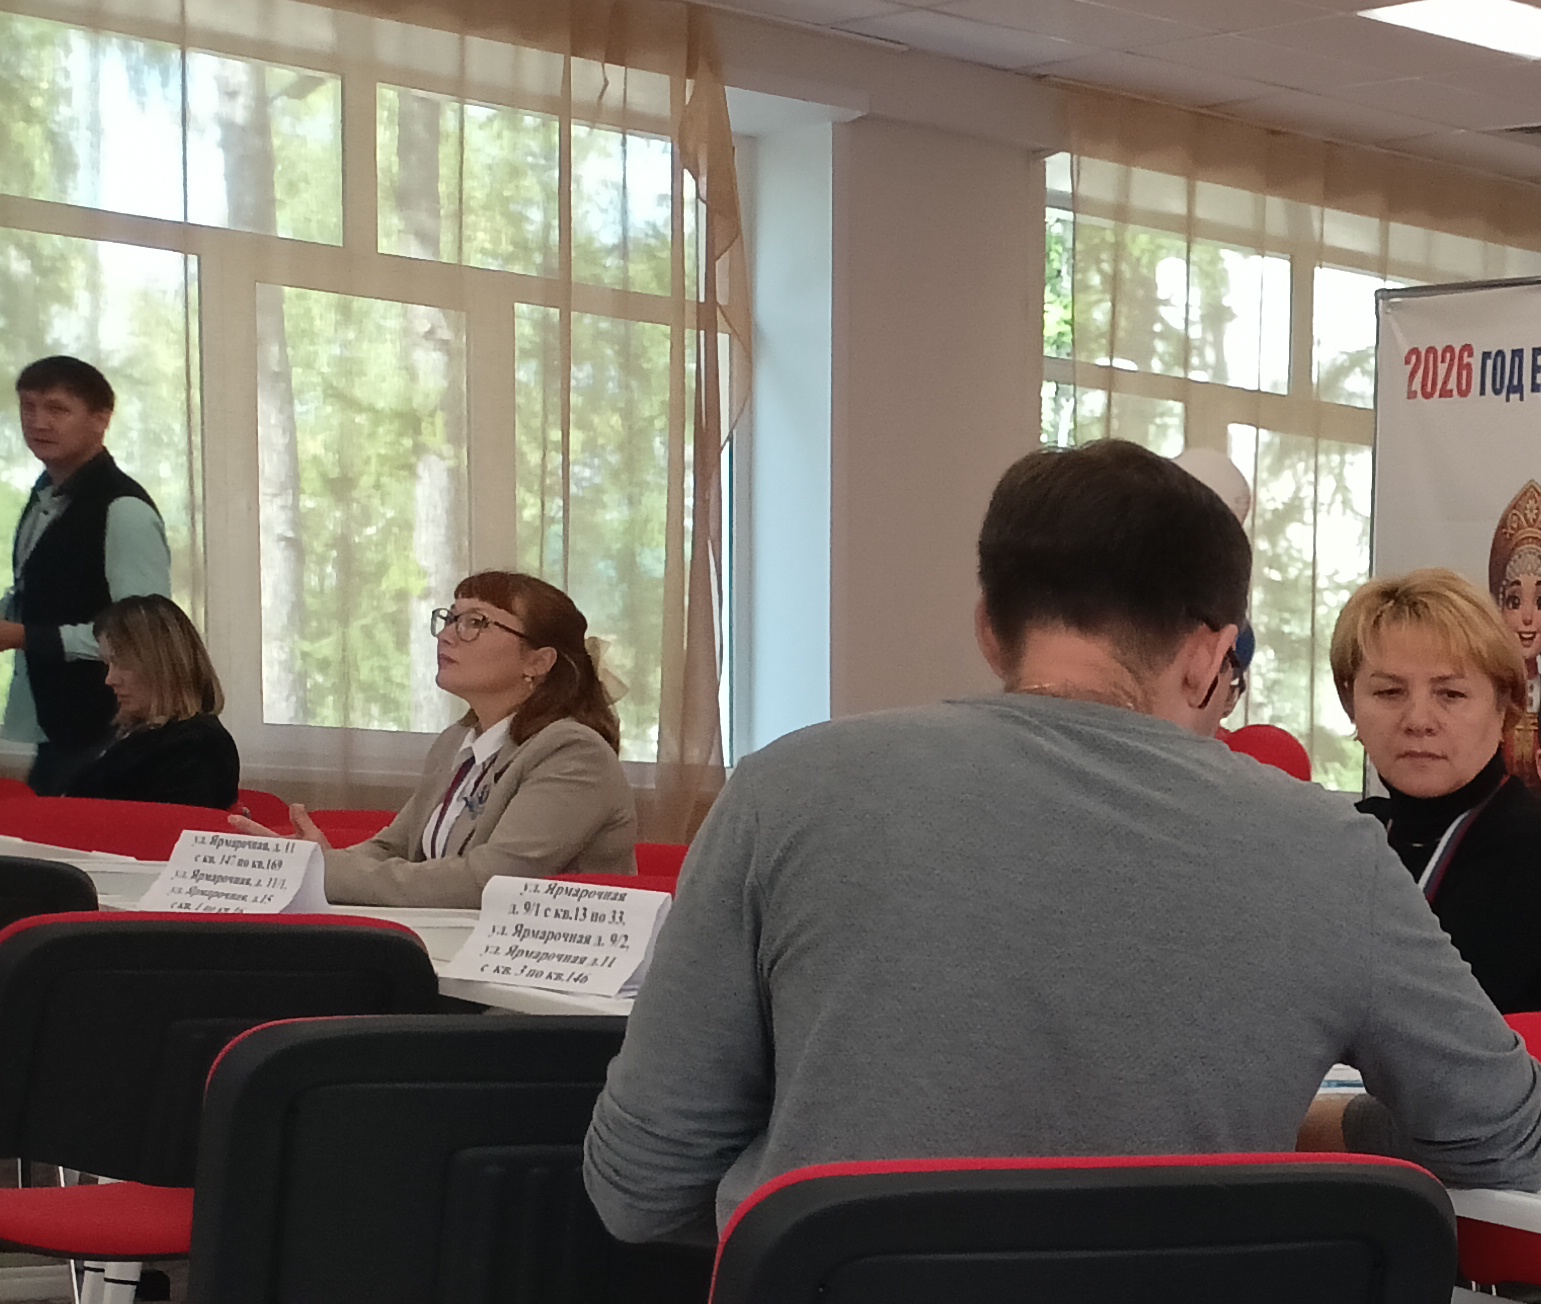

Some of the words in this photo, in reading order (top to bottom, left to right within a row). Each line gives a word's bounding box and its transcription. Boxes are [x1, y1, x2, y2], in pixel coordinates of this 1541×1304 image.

[1405, 343, 1474, 400] 2026
[1479, 348, 1525, 403] ГОД
[544, 882, 628, 902] Ярмарочная
[544, 907, 552, 918] с
[590, 911, 607, 923] по
[511, 923, 593, 944] Ярмарочная
[505, 944, 588, 963] Ярмарочная
